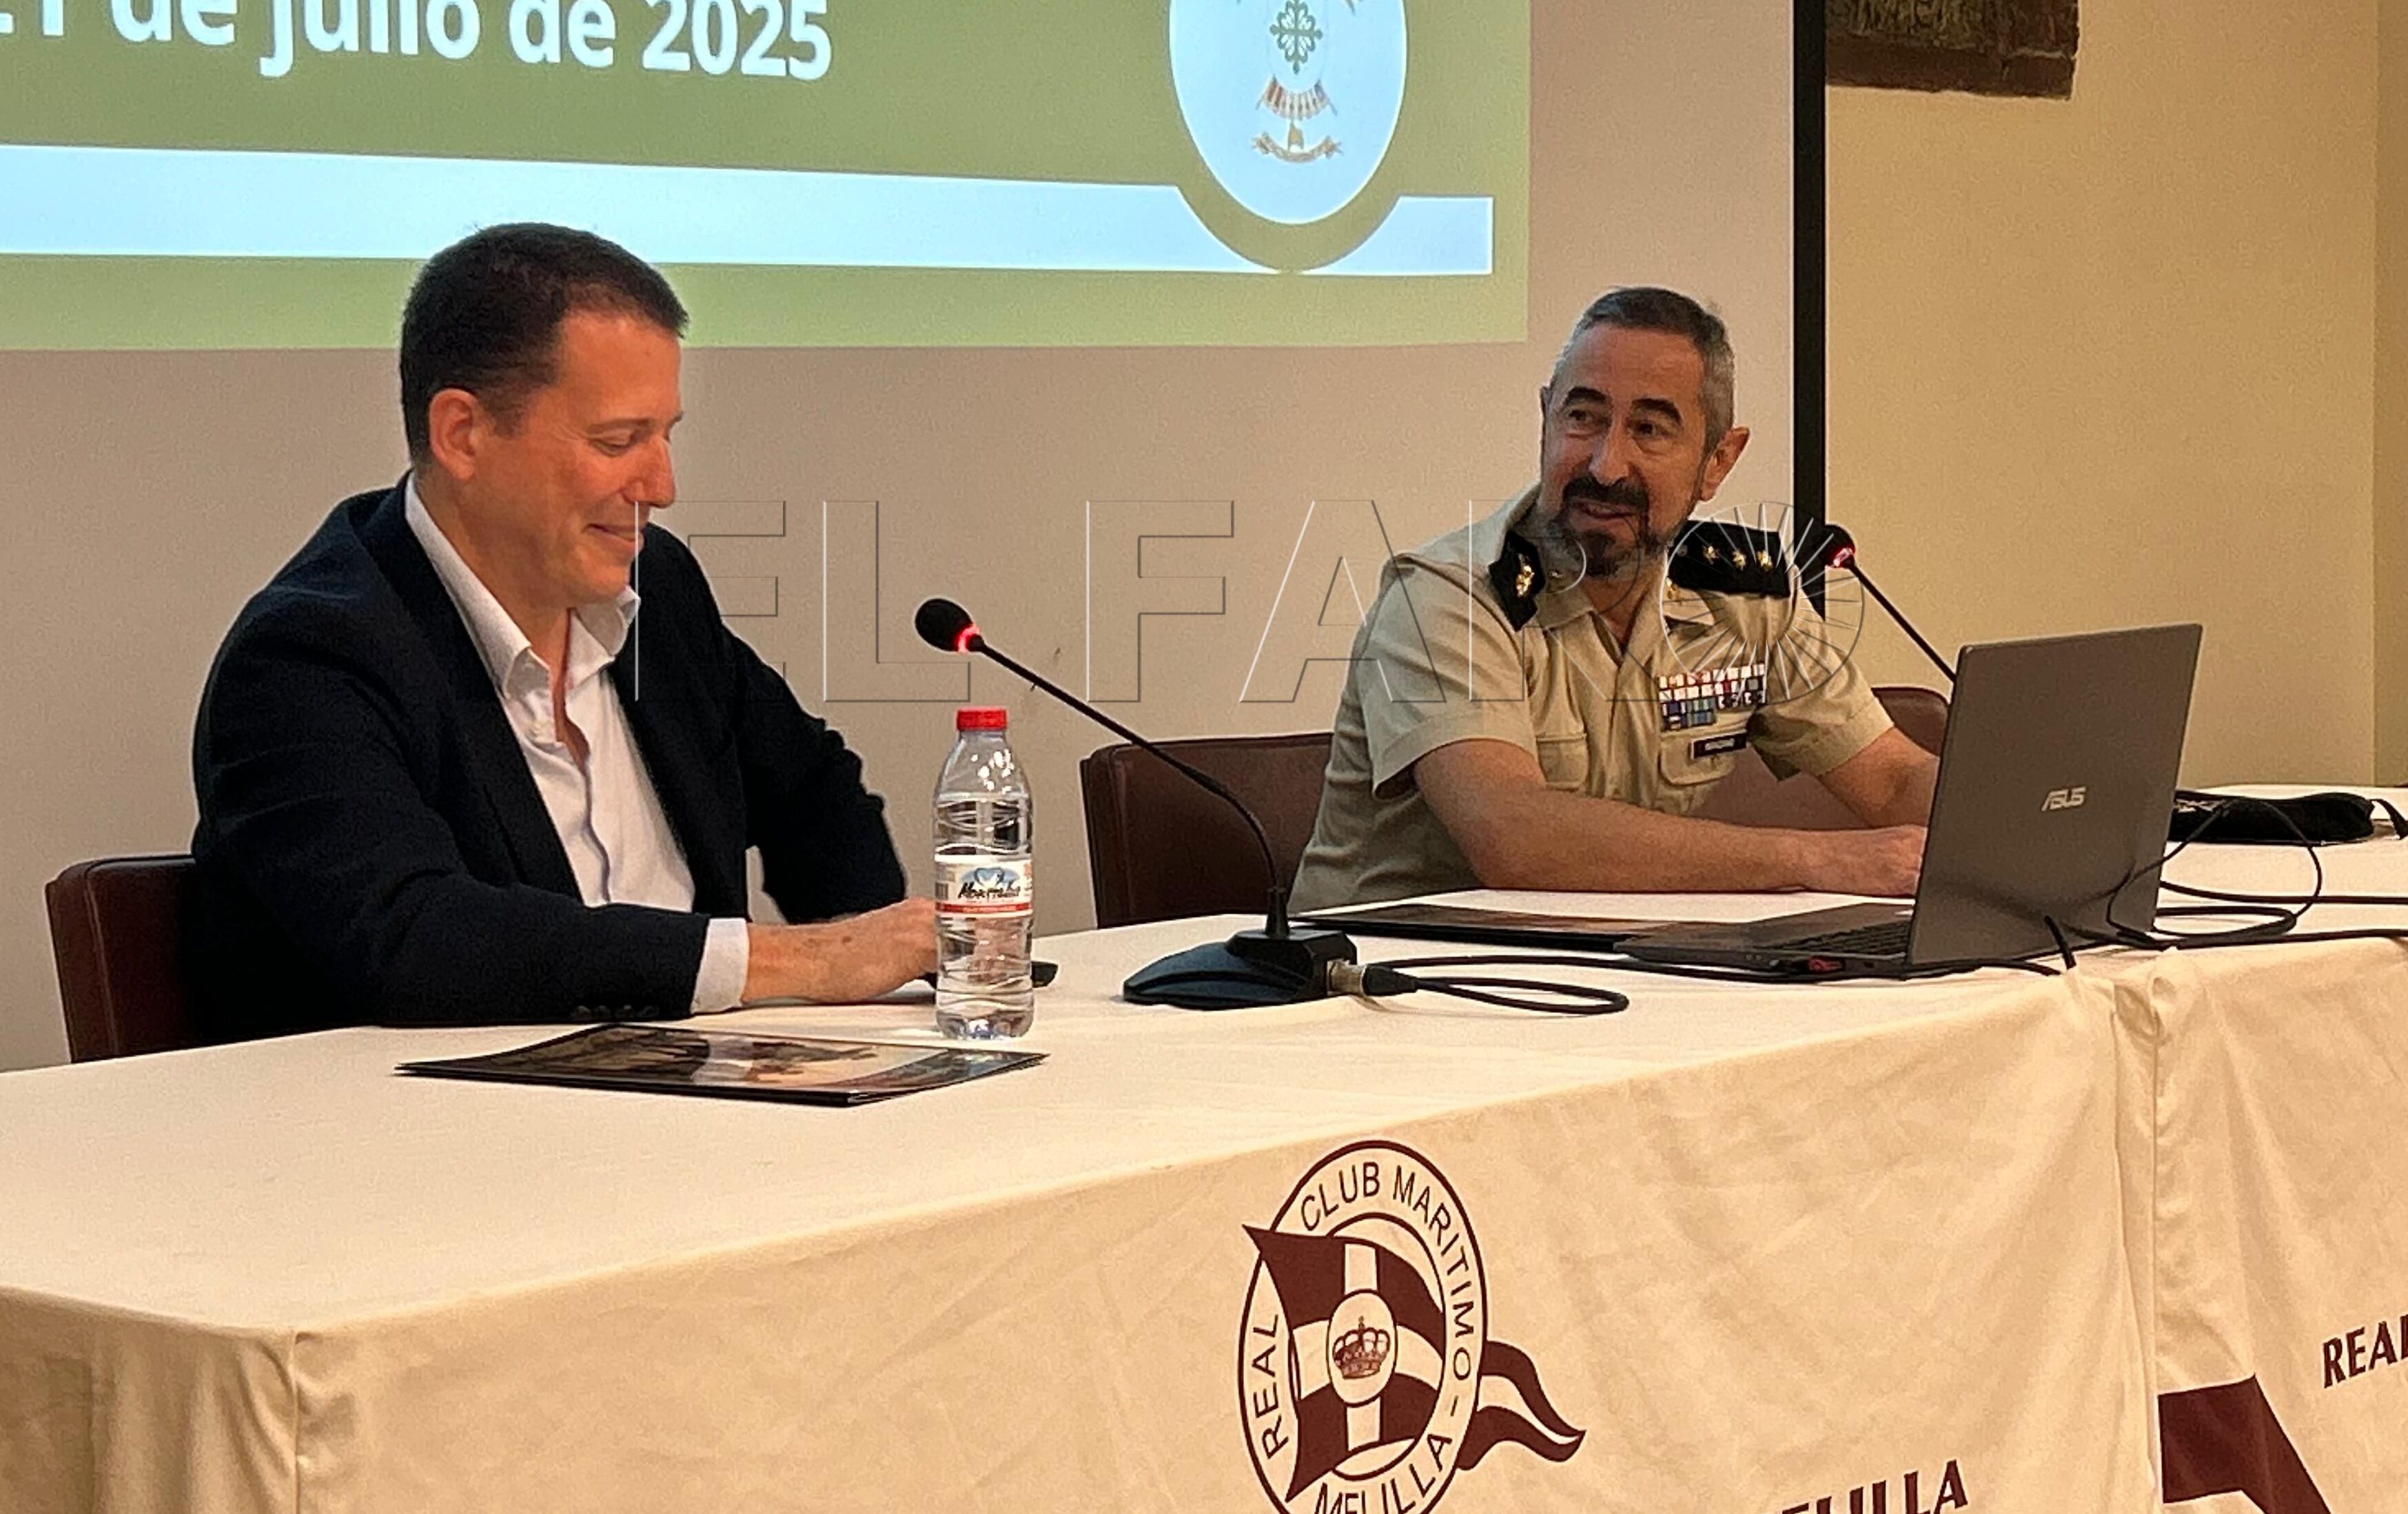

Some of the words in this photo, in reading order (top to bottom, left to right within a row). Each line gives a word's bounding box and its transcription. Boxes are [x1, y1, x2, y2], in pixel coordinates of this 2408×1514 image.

[259, 0, 480, 76] julio
[509, 0, 616, 68] de
[642, 0, 833, 81] 2025
[2041, 786, 2087, 812] ASUS
[1251, 1313, 1289, 1460] REAL
[1300, 1161, 1380, 1231] CLUB
[1393, 1165, 1476, 1380] MARITIMO
